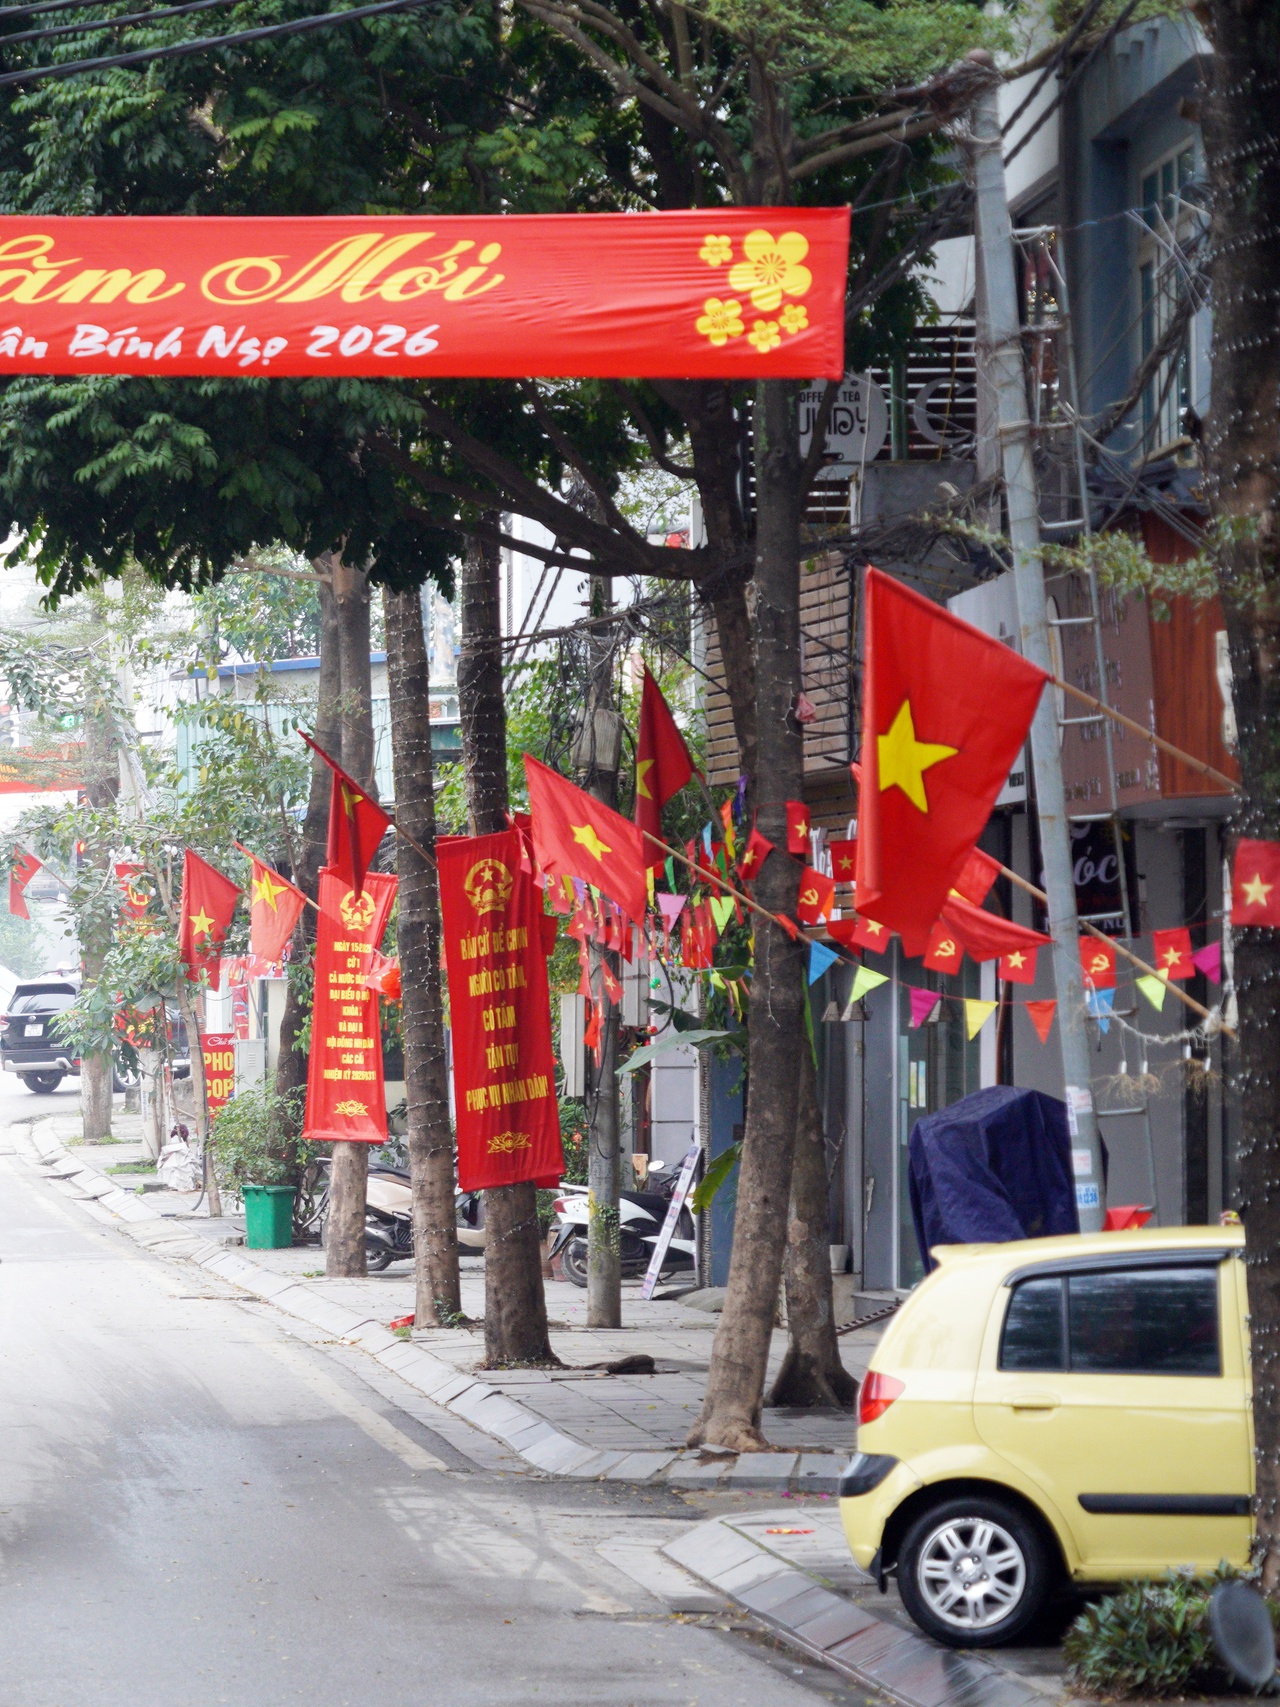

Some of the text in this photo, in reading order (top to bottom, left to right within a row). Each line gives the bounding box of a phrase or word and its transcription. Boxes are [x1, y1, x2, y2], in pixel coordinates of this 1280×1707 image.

[202, 232, 505, 304] Mới
[69, 324, 185, 360] Bính
[197, 325, 288, 366] Ngọ
[306, 324, 440, 357] 2026
[799, 391, 861, 403] OFFE TEA
[1060, 845, 1120, 887] óc
[461, 930, 477, 960] BẦU
[477, 927, 489, 956] CỬ
[493, 922, 505, 953] ĐỂ
[469, 962, 528, 997] NGƯỜI CÓ TÂM,
[483, 1001, 516, 1031] CÓ TẦM
[203, 1052, 235, 1071] PHO
[485, 1042, 504, 1073] TẬN
[206, 1078, 235, 1098] COP
[466, 1073, 549, 1114] PHỤC VỤ NHÂN DÂN!
